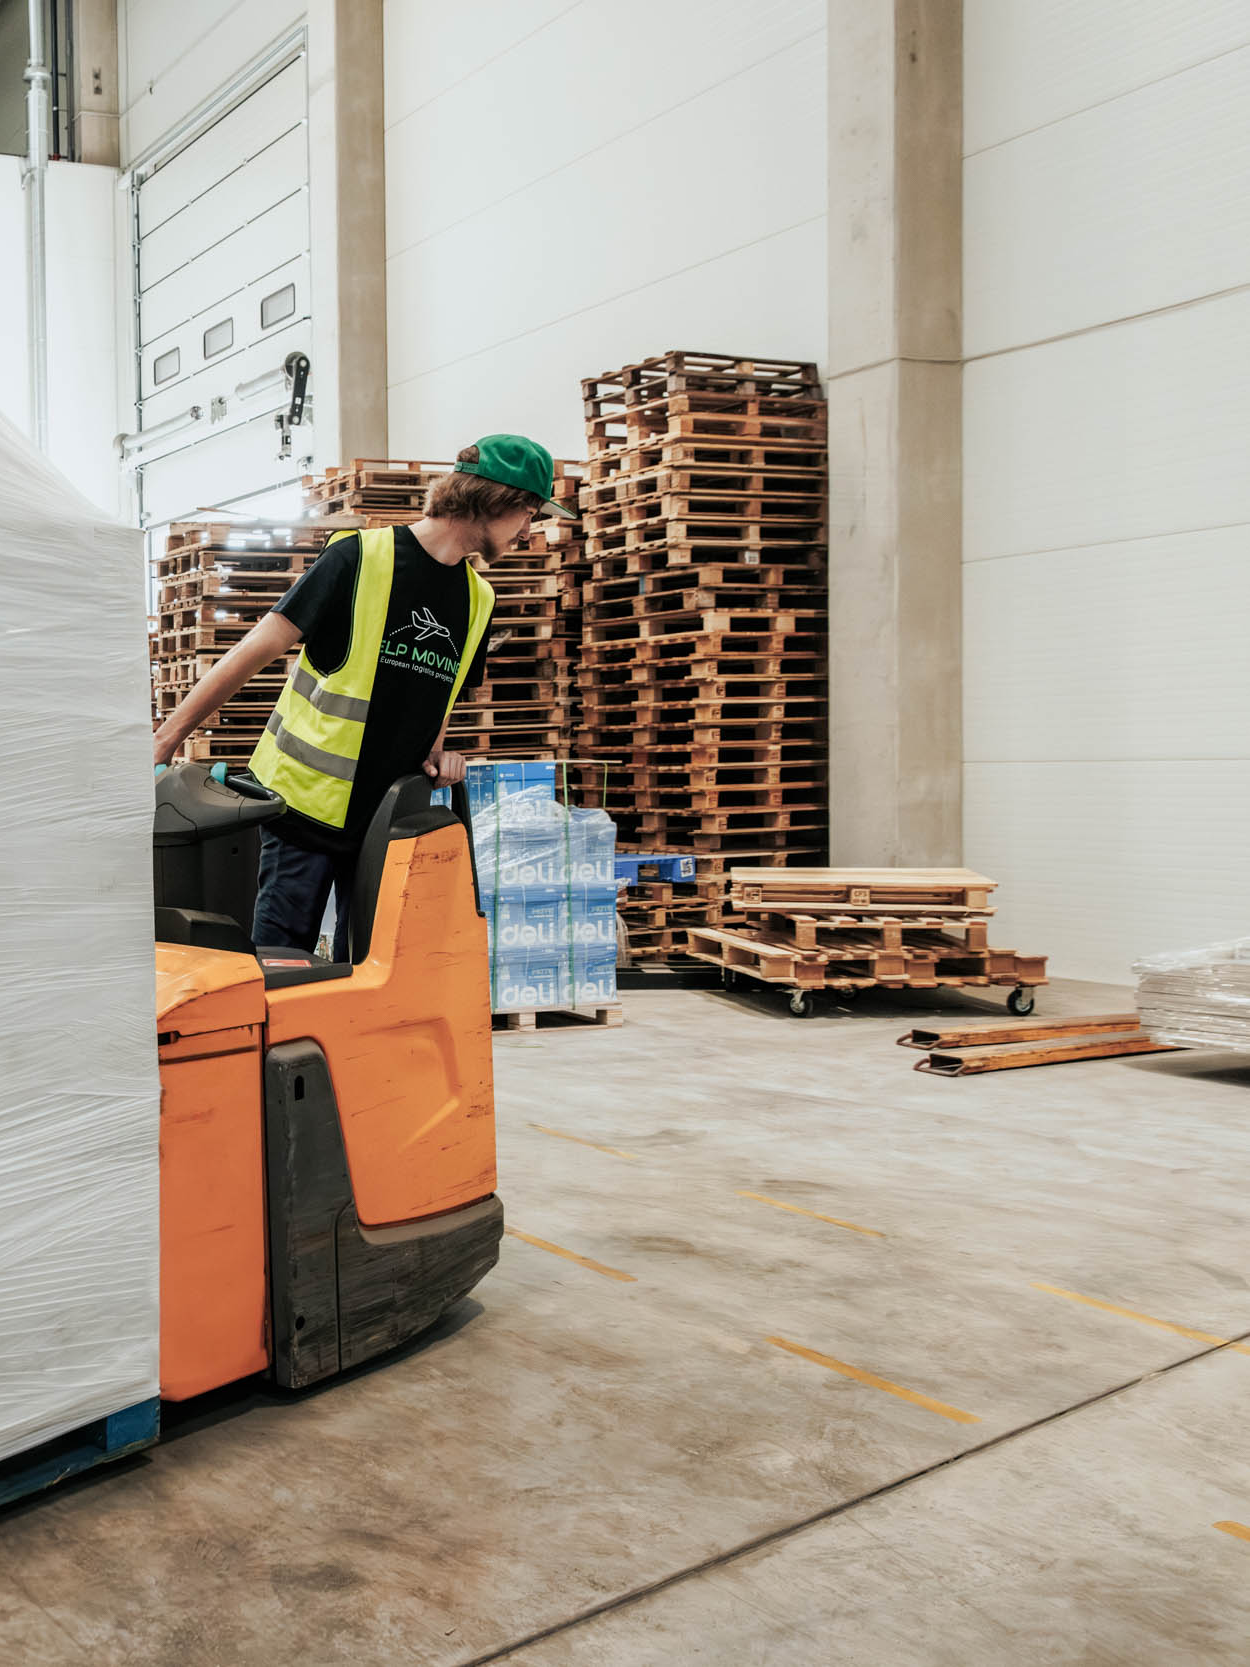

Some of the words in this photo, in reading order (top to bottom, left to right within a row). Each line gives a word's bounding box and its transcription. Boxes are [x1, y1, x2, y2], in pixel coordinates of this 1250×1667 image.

[380, 656, 410, 670] European
[412, 664, 435, 677] logistics
[501, 861, 554, 885] deli
[501, 922, 555, 945] deli
[502, 982, 555, 1005] deli
